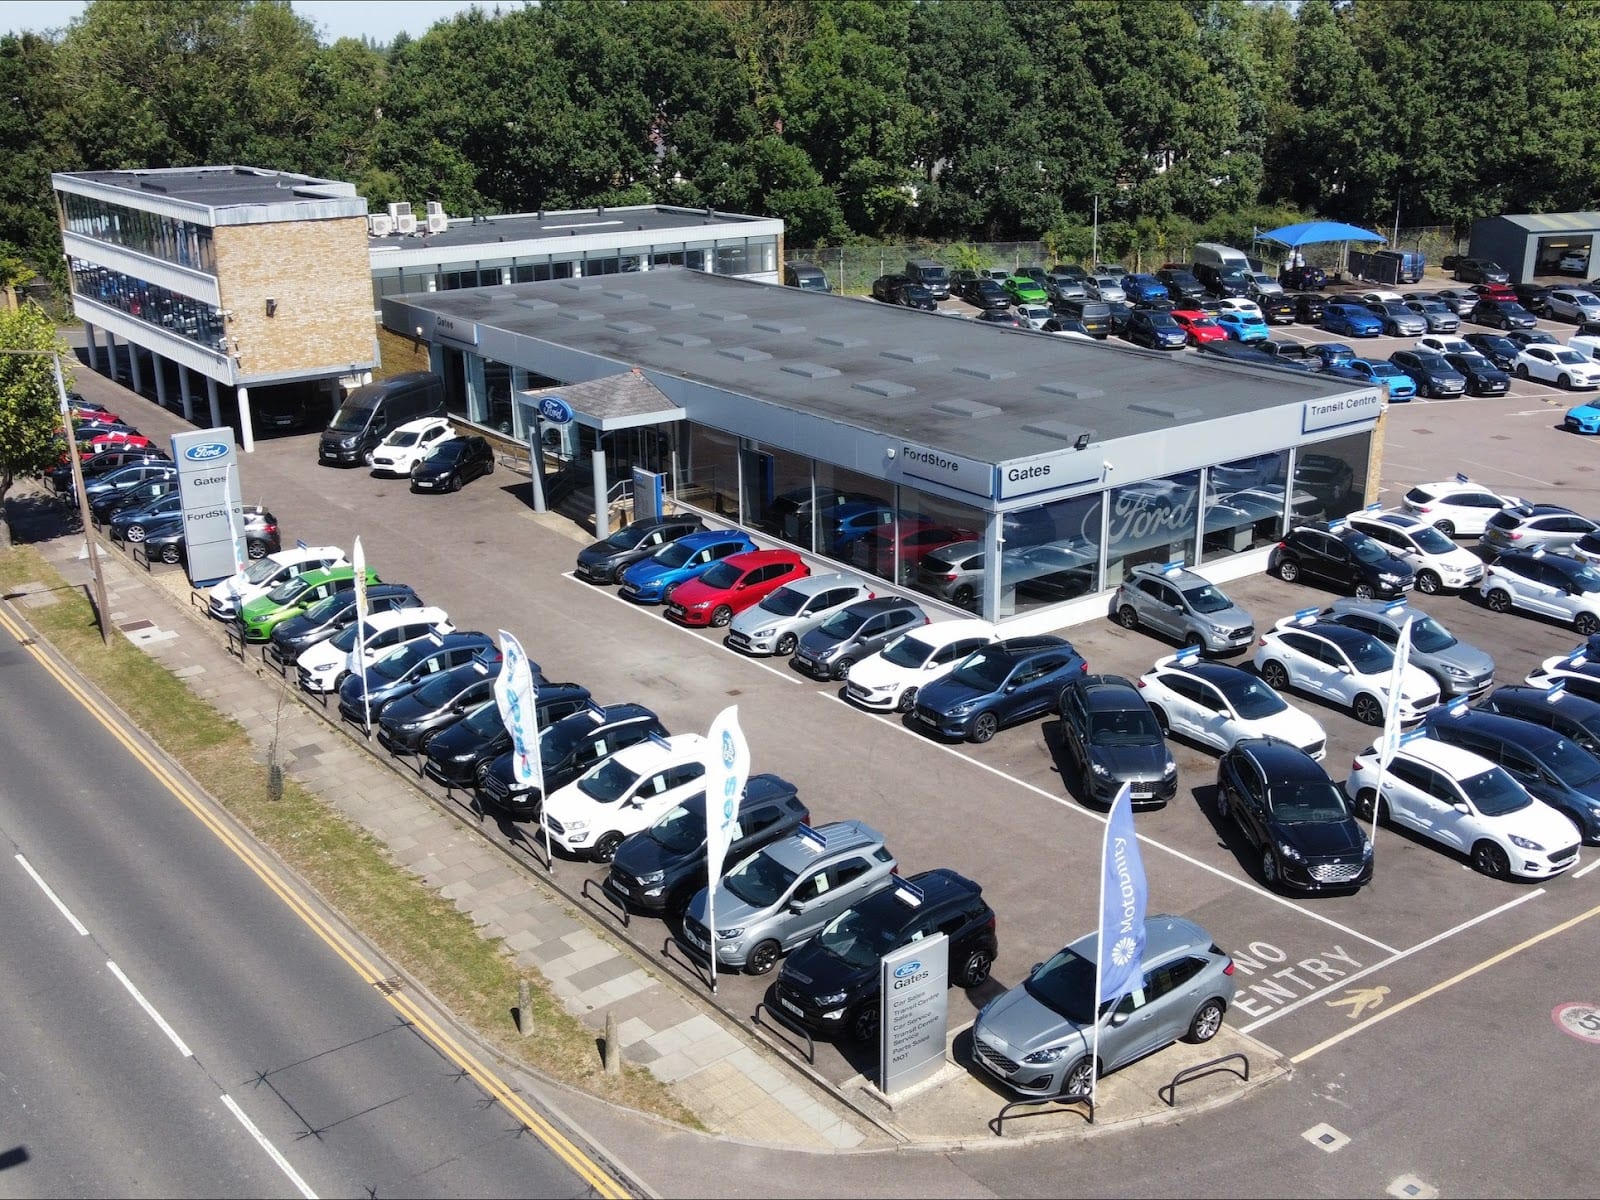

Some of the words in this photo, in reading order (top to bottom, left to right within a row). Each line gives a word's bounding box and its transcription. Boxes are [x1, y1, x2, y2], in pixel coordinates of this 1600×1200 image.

[1311, 401, 1344, 415] Transit
[1346, 396, 1377, 409] Centre
[903, 447, 959, 471] FordStore
[1008, 465, 1051, 481] Gates
[1109, 488, 1197, 545] Ford
[1114, 837, 1136, 934] Motability
[1232, 941, 1288, 976] NO
[894, 970, 929, 990] Gates
[1231, 945, 1363, 1017] ENTRY
[893, 1000, 906, 1008] Car
[907, 992, 926, 1003] Sales
[894, 1002, 917, 1016] Transit
[917, 992, 940, 1006] Centre
[893, 1012, 912, 1023] Sales
[893, 1022, 906, 1031] Car
[907, 1012, 932, 1025] Service
[893, 1026, 917, 1039] Transit
[917, 1015, 939, 1029] Centre
[892, 1044, 911, 1055] Parts
[911, 1035, 930, 1047] Sales
[893, 1032, 919, 1046] Service
[892, 1052, 909, 1063] MOT
